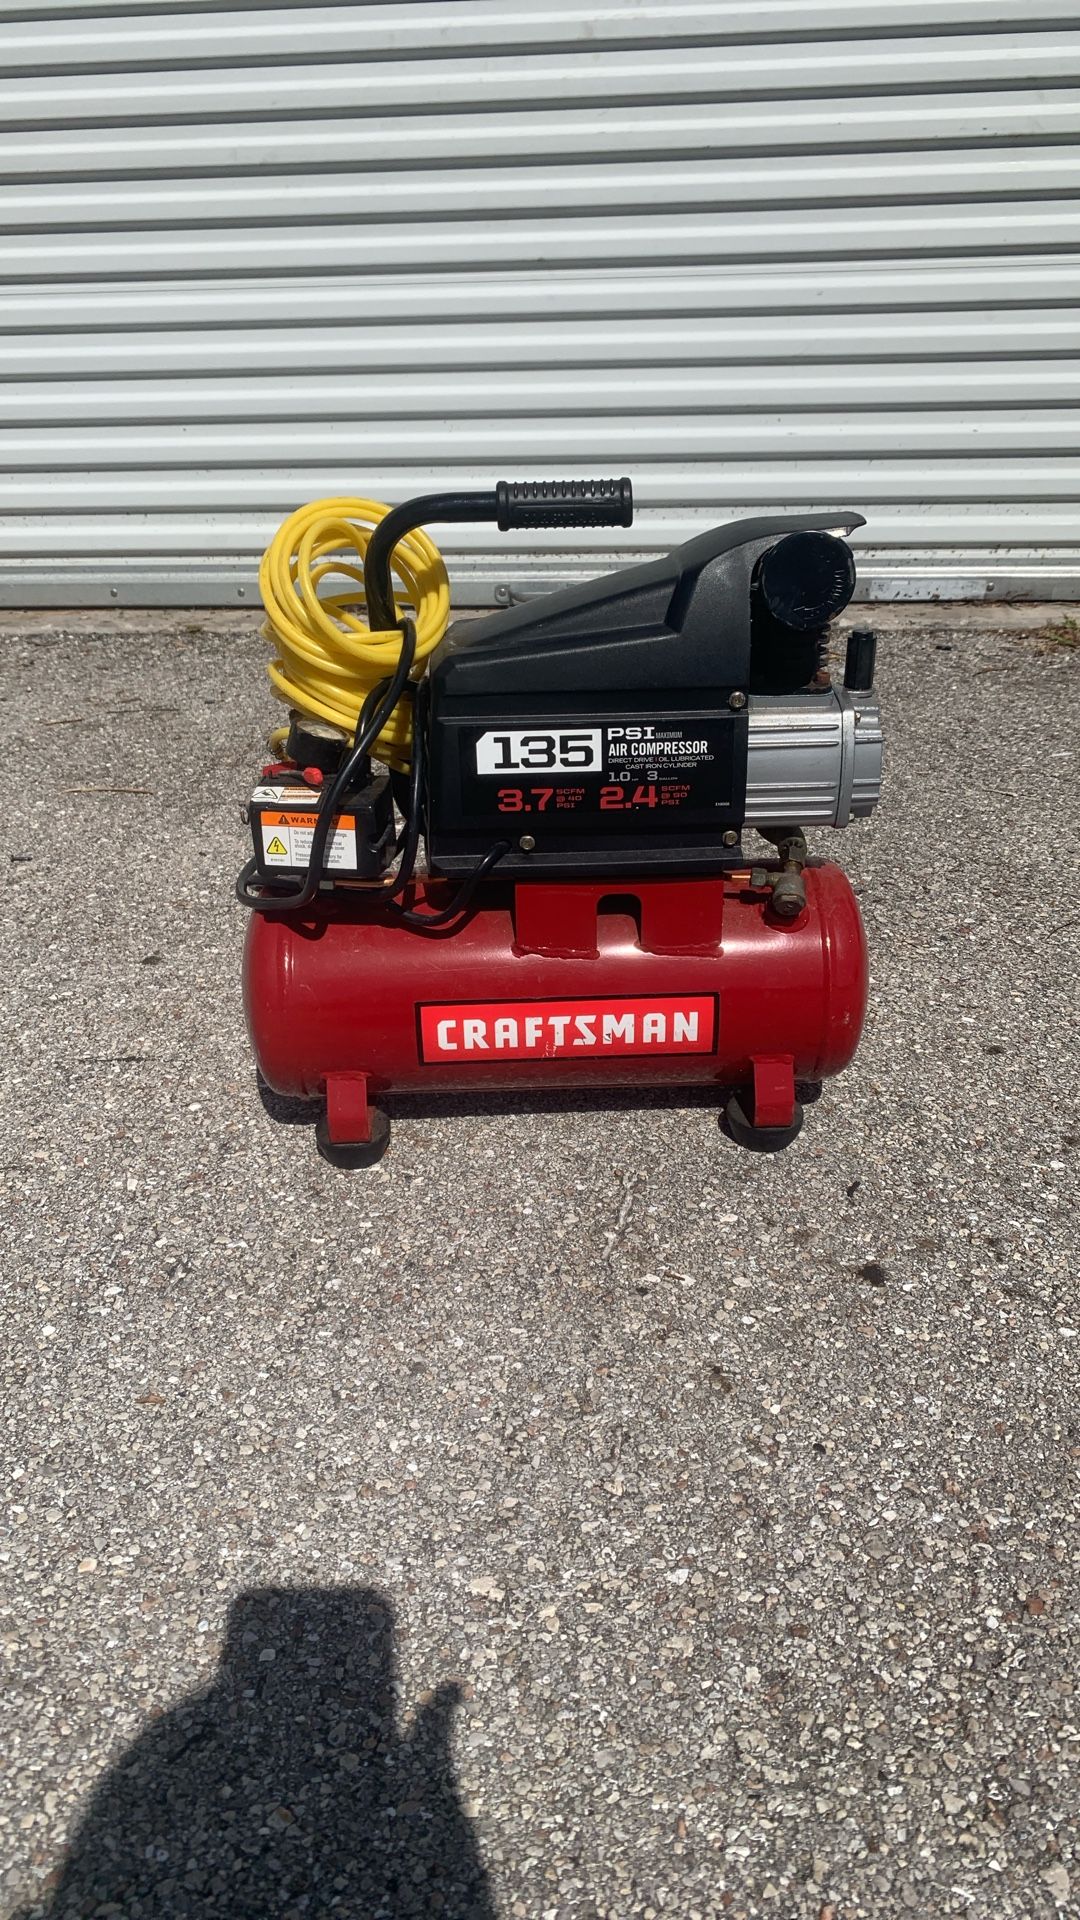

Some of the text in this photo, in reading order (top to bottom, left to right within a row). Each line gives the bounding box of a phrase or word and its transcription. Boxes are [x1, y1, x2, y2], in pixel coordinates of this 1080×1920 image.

[493, 726, 683, 769] 135 PSI MAXIMUM
[608, 740, 708, 756] AIR COMPRESSOR
[670, 754, 714, 762] LUBRICATED
[608, 771, 631, 782] 1.0
[647, 770, 658, 781] 3
[497, 788, 554, 812] 3.7
[600, 785, 658, 809] 2.4
[437, 1011, 699, 1050] CRAFTSMAN
